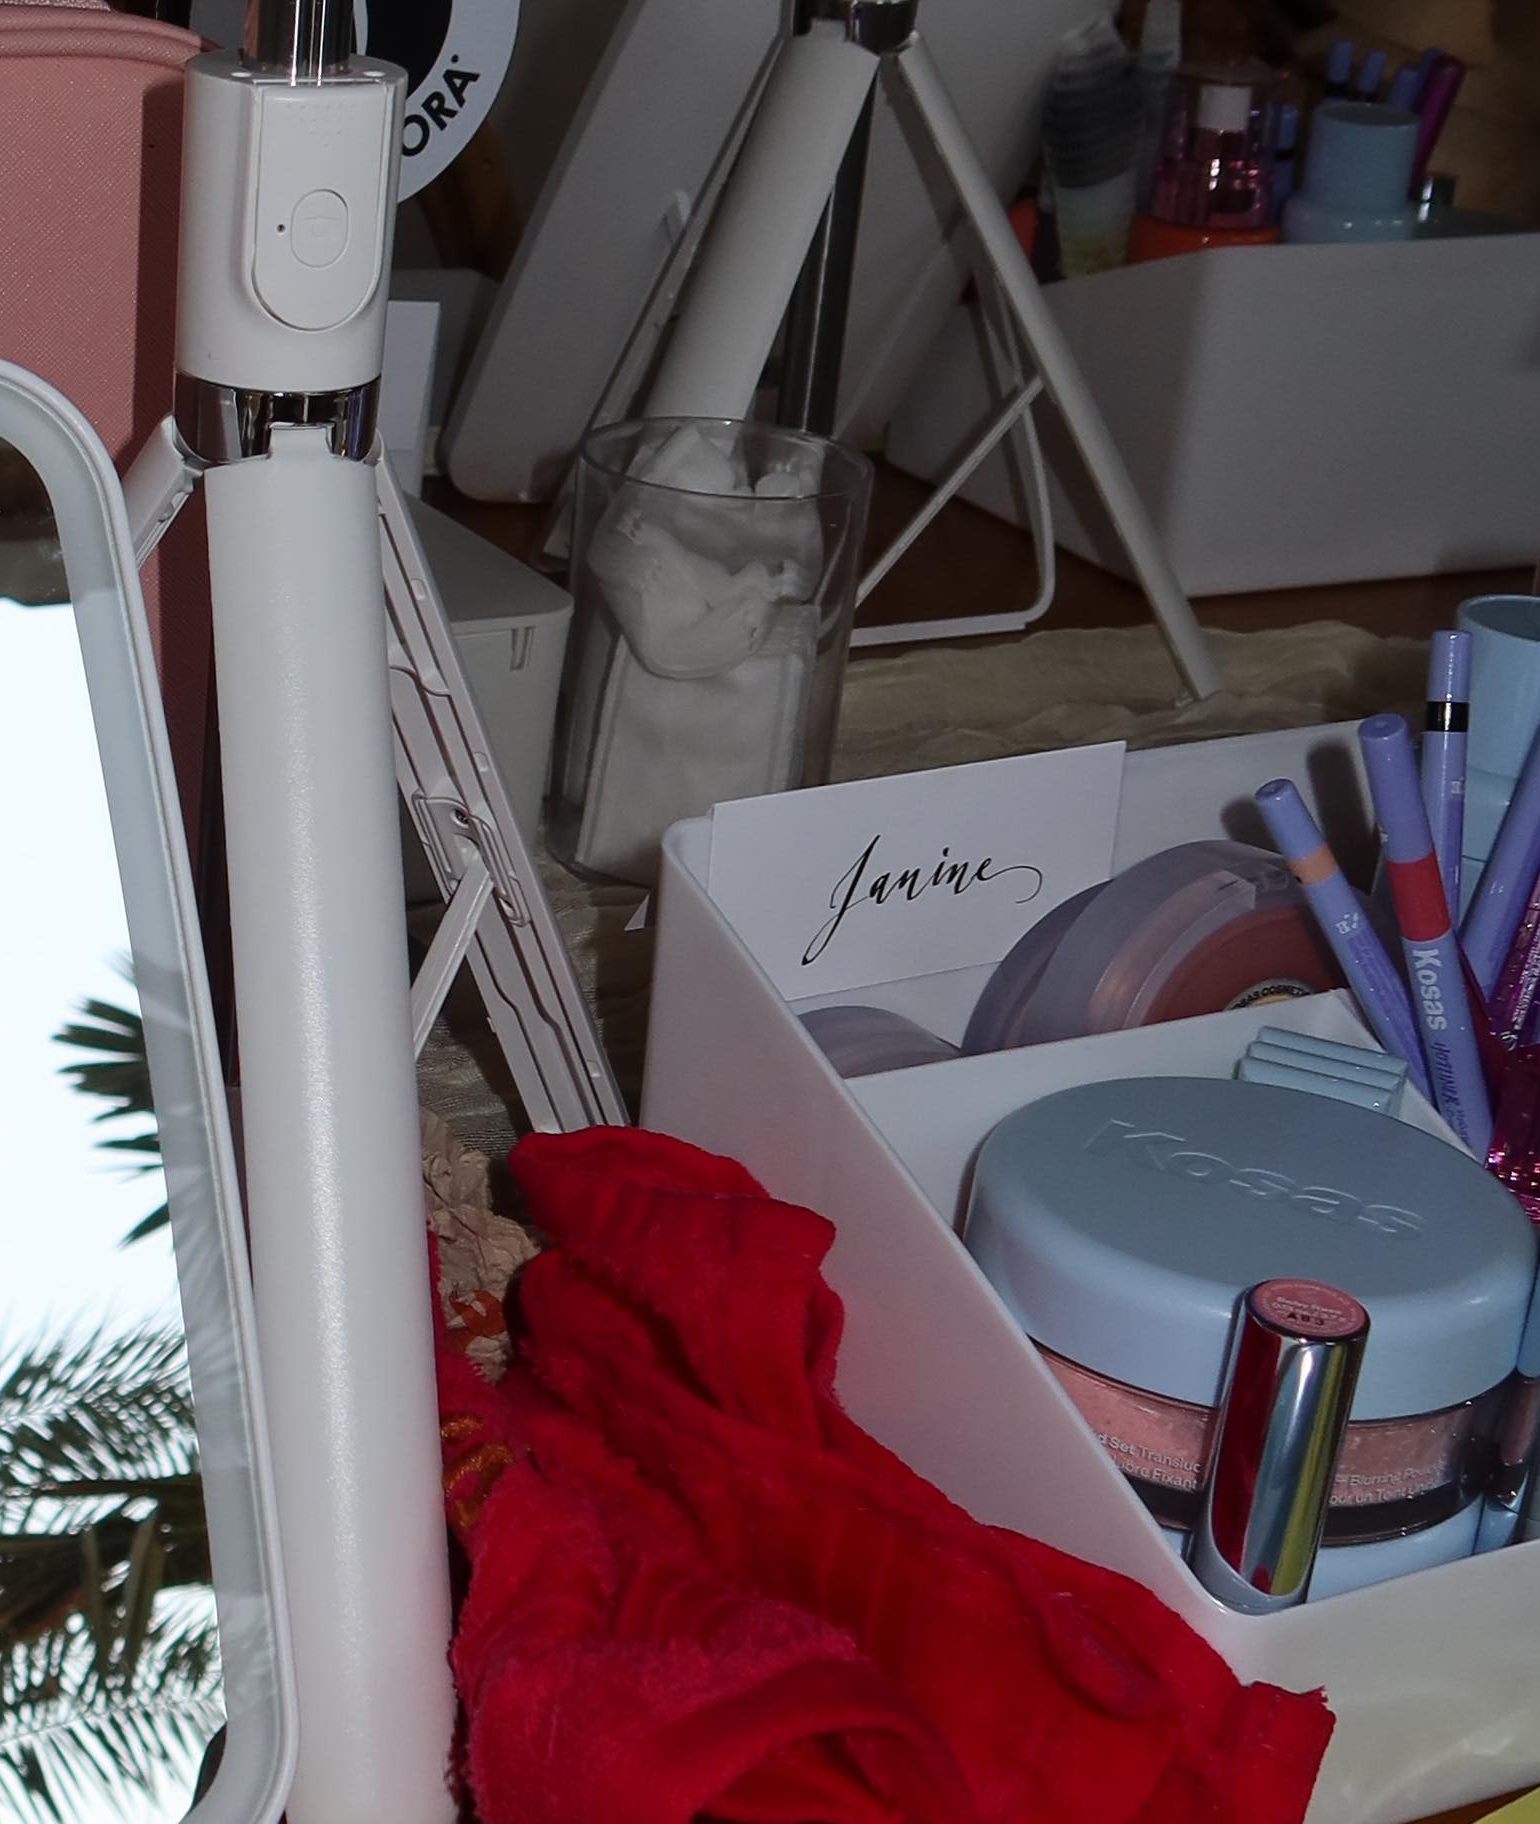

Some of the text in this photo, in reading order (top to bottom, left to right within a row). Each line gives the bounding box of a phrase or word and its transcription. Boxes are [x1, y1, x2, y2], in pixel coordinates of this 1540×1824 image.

[801, 835, 1043, 966] Janine
[1412, 949, 1449, 1031] Kosas
[1084, 1119, 1426, 1241] Kosas
